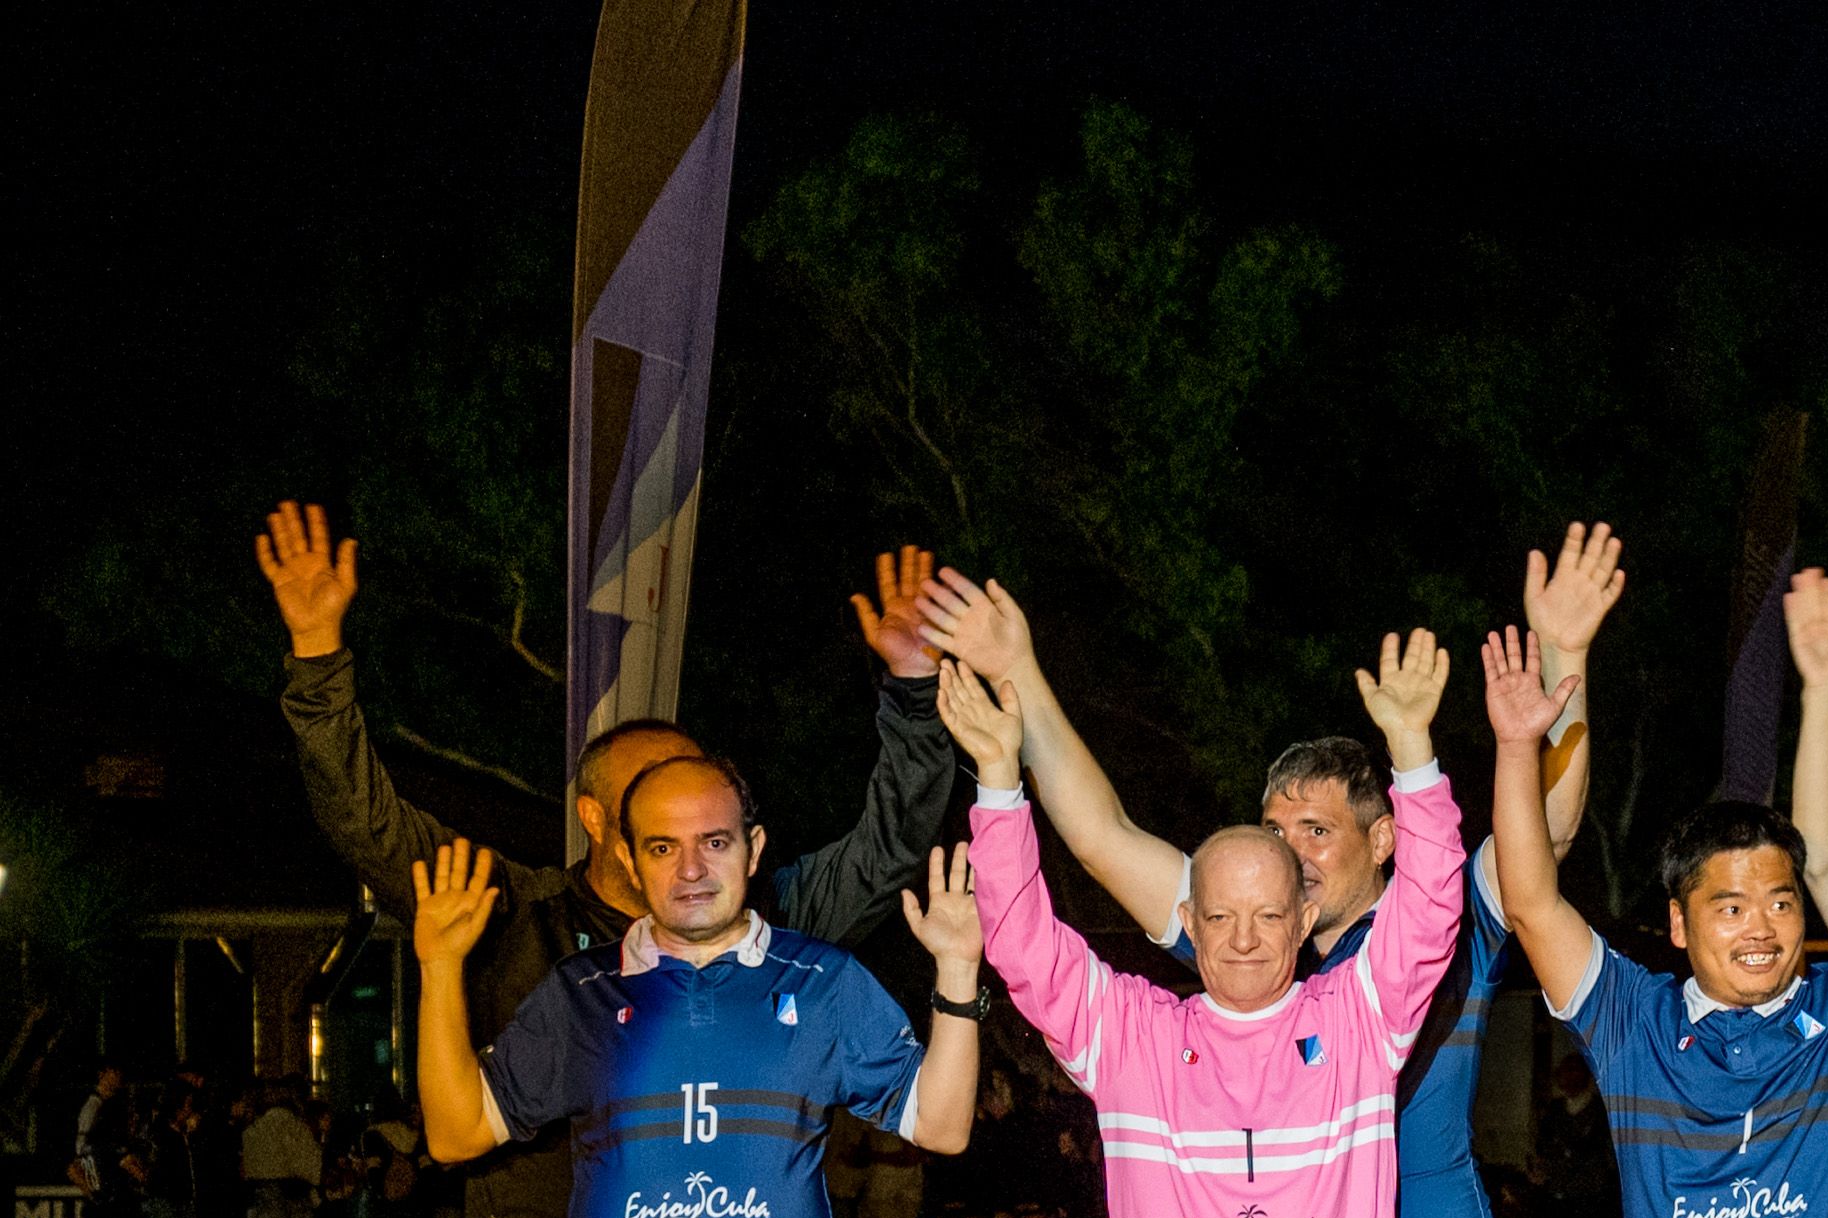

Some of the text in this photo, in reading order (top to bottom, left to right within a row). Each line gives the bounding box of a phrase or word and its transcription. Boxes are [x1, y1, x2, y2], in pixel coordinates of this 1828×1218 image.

[681, 1082, 719, 1144] 15
[1241, 1128, 1254, 1183] 1
[706, 1186, 771, 1218] Cuba
[1751, 1181, 1808, 1218] Cuba
